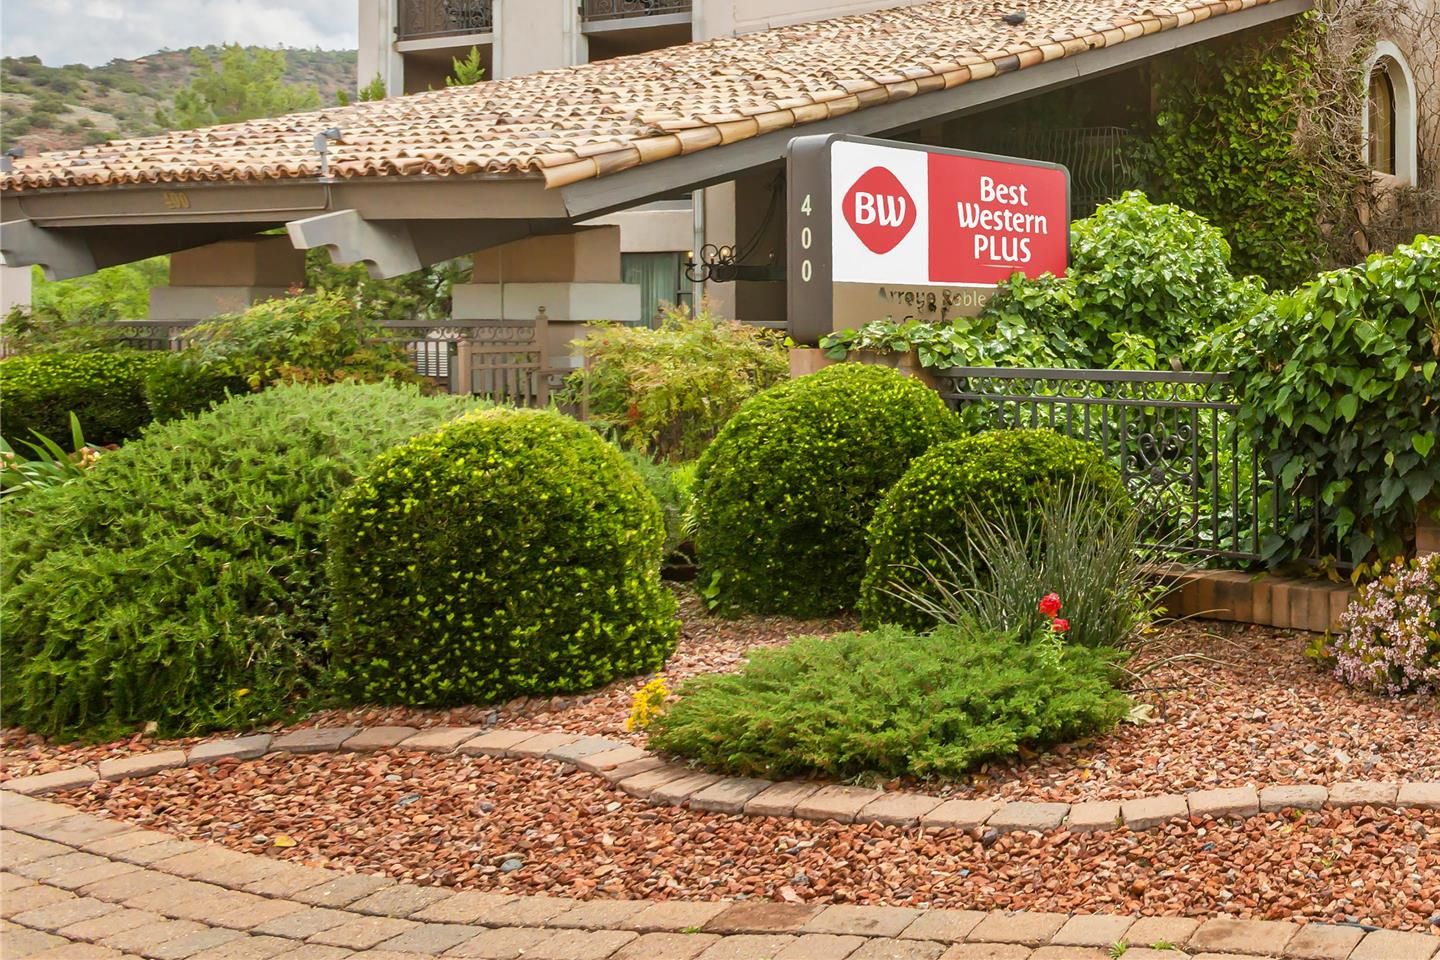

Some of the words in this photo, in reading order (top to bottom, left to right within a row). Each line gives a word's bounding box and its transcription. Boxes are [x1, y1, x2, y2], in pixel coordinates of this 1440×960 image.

[980, 175, 1028, 207] Best
[855, 191, 906, 228] BW
[957, 201, 1048, 235] Western
[974, 234, 1032, 263] PLUS
